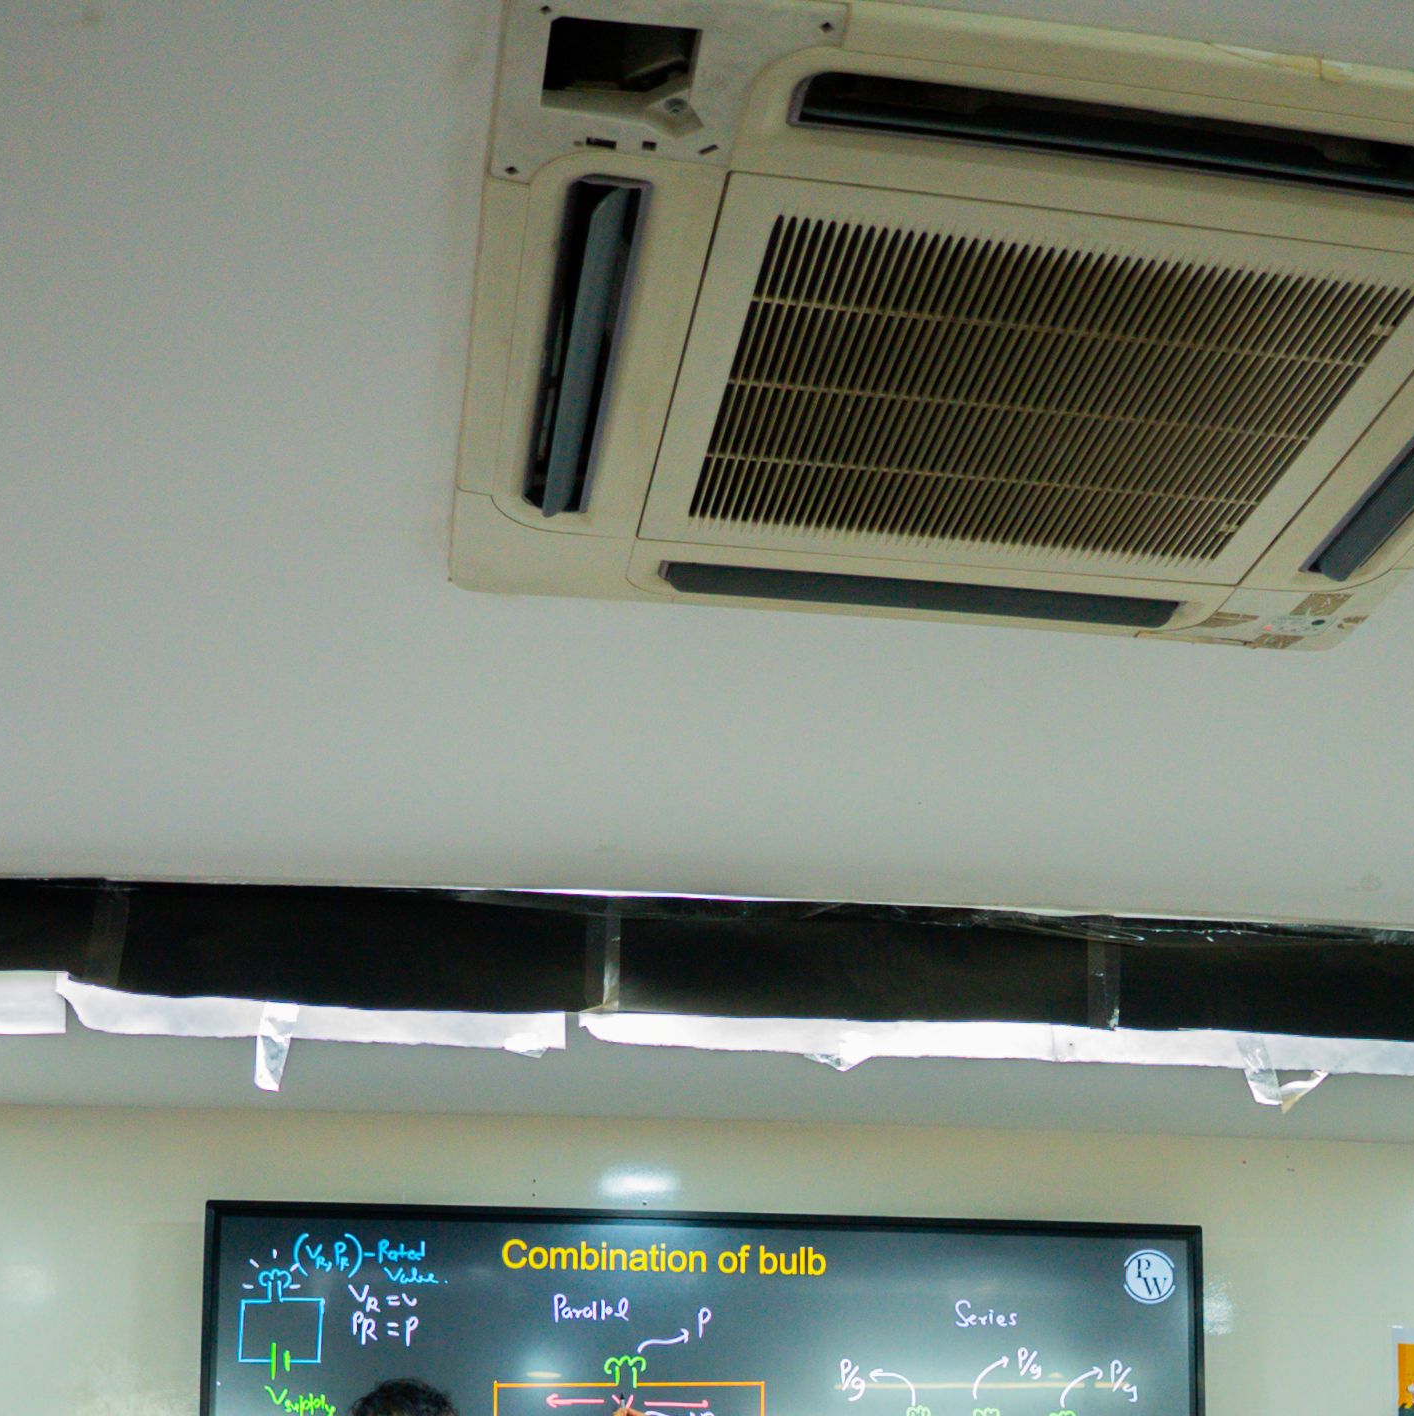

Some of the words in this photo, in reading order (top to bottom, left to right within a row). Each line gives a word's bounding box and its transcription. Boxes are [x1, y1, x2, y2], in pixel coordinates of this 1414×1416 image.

[501, 1238, 707, 1273] Combination
[718, 1245, 751, 1274] of
[759, 1245, 827, 1276] bulb
[954, 1299, 1018, 1329] Series
